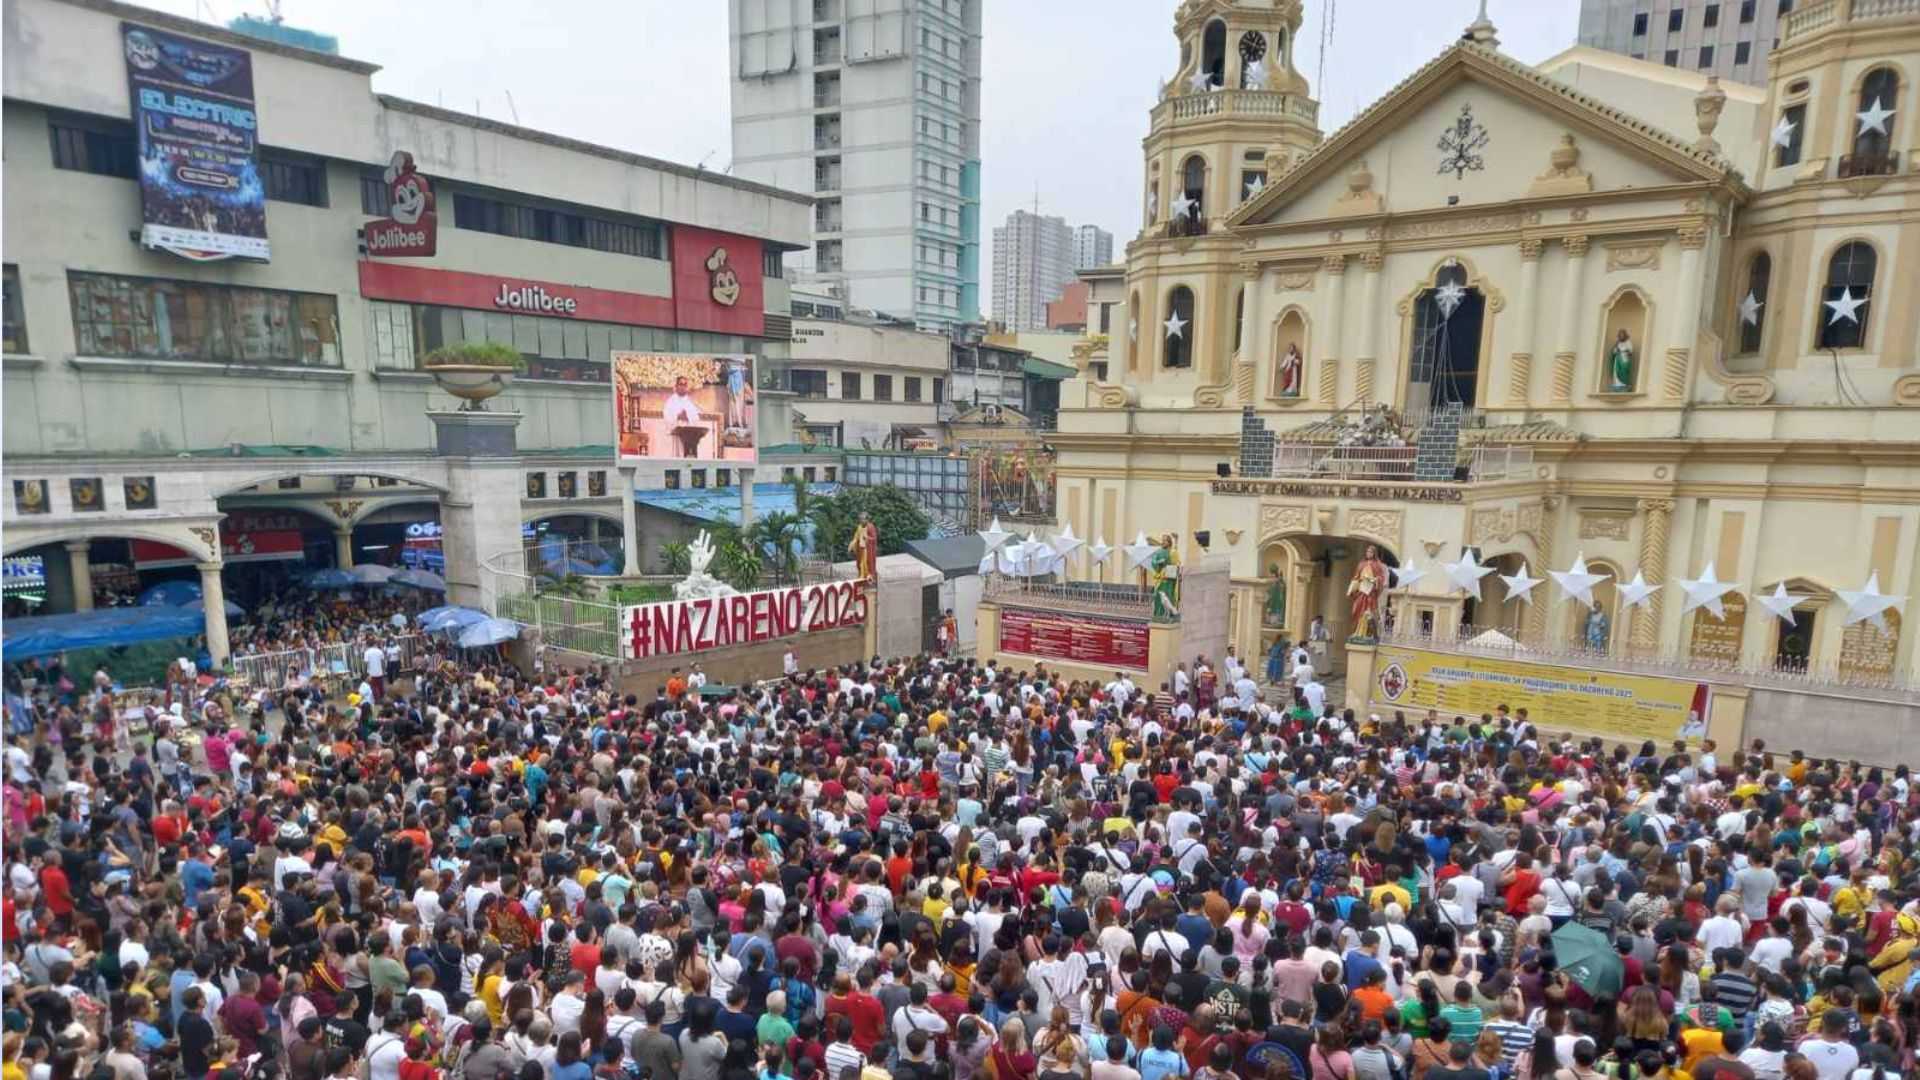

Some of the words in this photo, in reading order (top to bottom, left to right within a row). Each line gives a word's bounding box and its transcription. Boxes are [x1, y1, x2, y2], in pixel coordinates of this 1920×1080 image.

[140, 88, 256, 130] ELECTRIC
[370, 227, 425, 249] Jollibee
[496, 284, 576, 313] Jollibee
[1280, 483, 1335, 497] DAMA
[1393, 488, 1463, 502] NAZARENO
[243, 515, 300, 530] PLAZA
[631, 587, 800, 658] #NAZARENO
[808, 580, 869, 632] 2025
